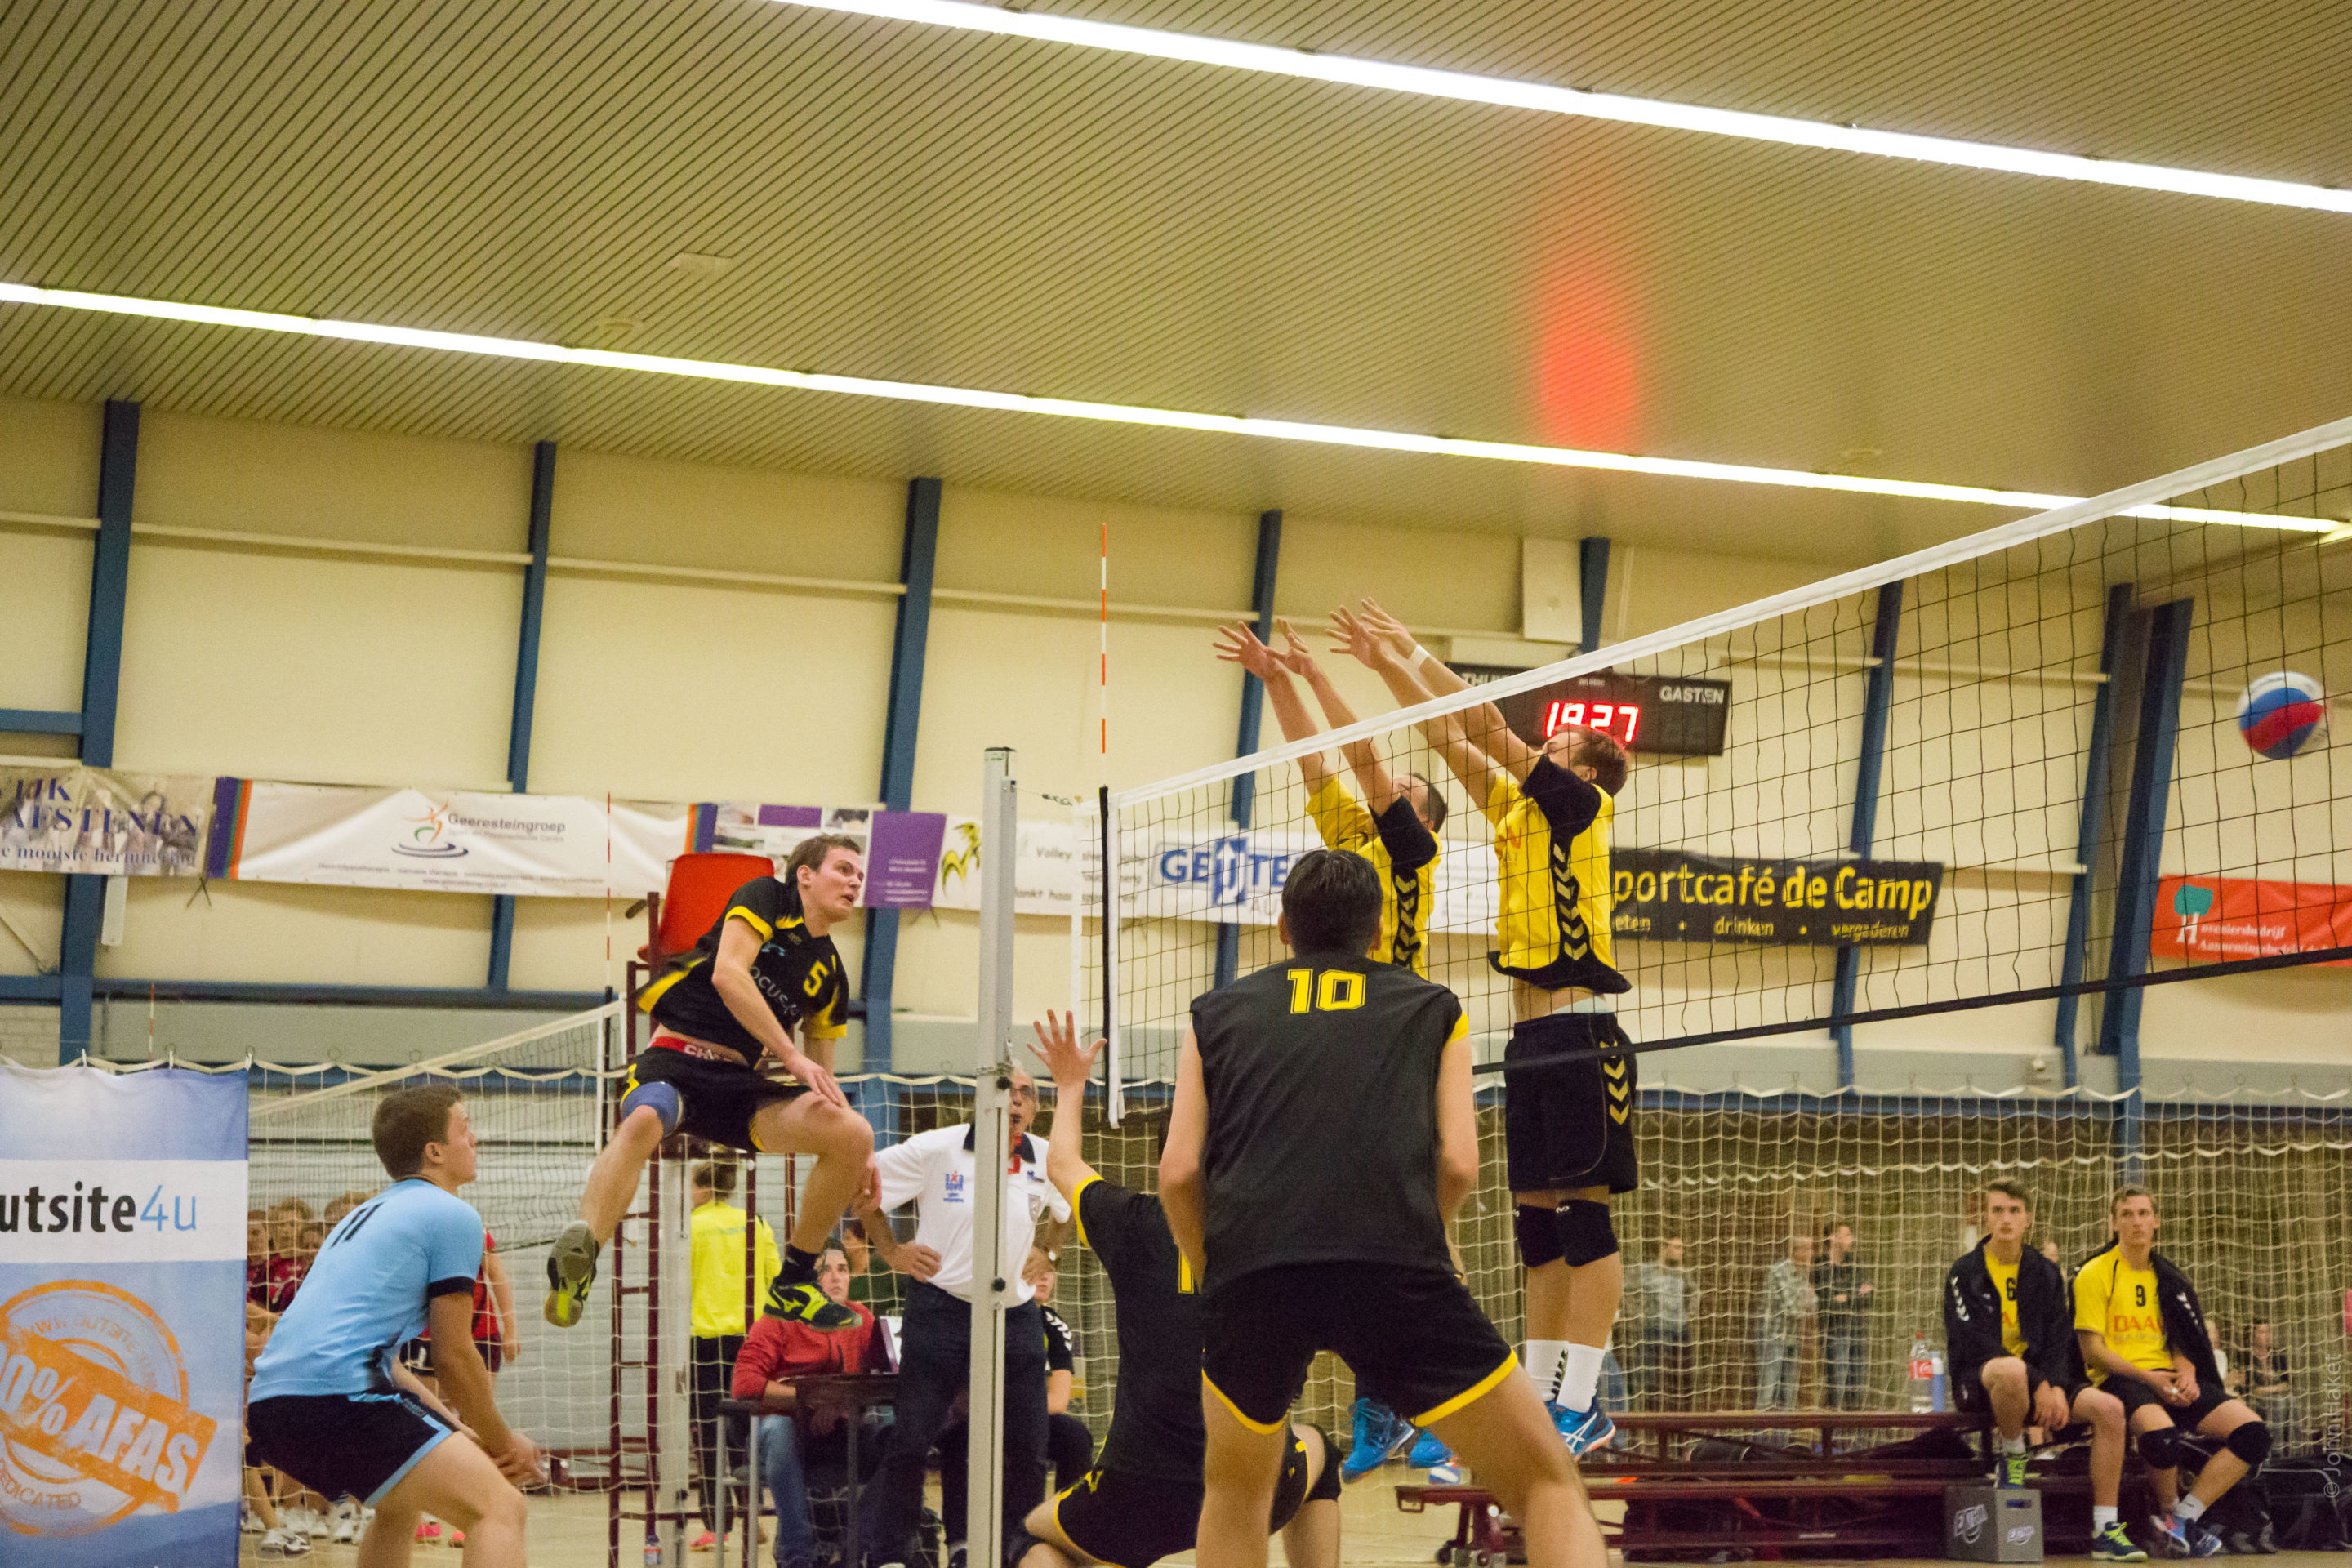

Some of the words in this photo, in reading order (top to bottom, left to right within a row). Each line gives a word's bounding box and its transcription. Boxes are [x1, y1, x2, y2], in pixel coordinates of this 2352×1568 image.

[1659, 686, 1724, 704] GASTEN
[448, 813, 565, 834] Geeresteingroep
[1610, 862, 1775, 911] portcafé
[1782, 866, 1827, 908] de
[1834, 866, 1933, 920] Camp
[1615, 915, 1650, 932] eten
[1715, 916, 1774, 936] drinken
[1832, 921, 1909, 942] vergaderen
[804, 960, 830, 997] 5
[1288, 969, 1366, 1014] 10
[0, 1181, 196, 1232] utsite4u
[2006, 1277, 2018, 1301] 6
[2136, 1285, 2146, 1307] 9
[0, 1353, 76, 1436] 0%
[68, 1393, 198, 1494] AFAS
